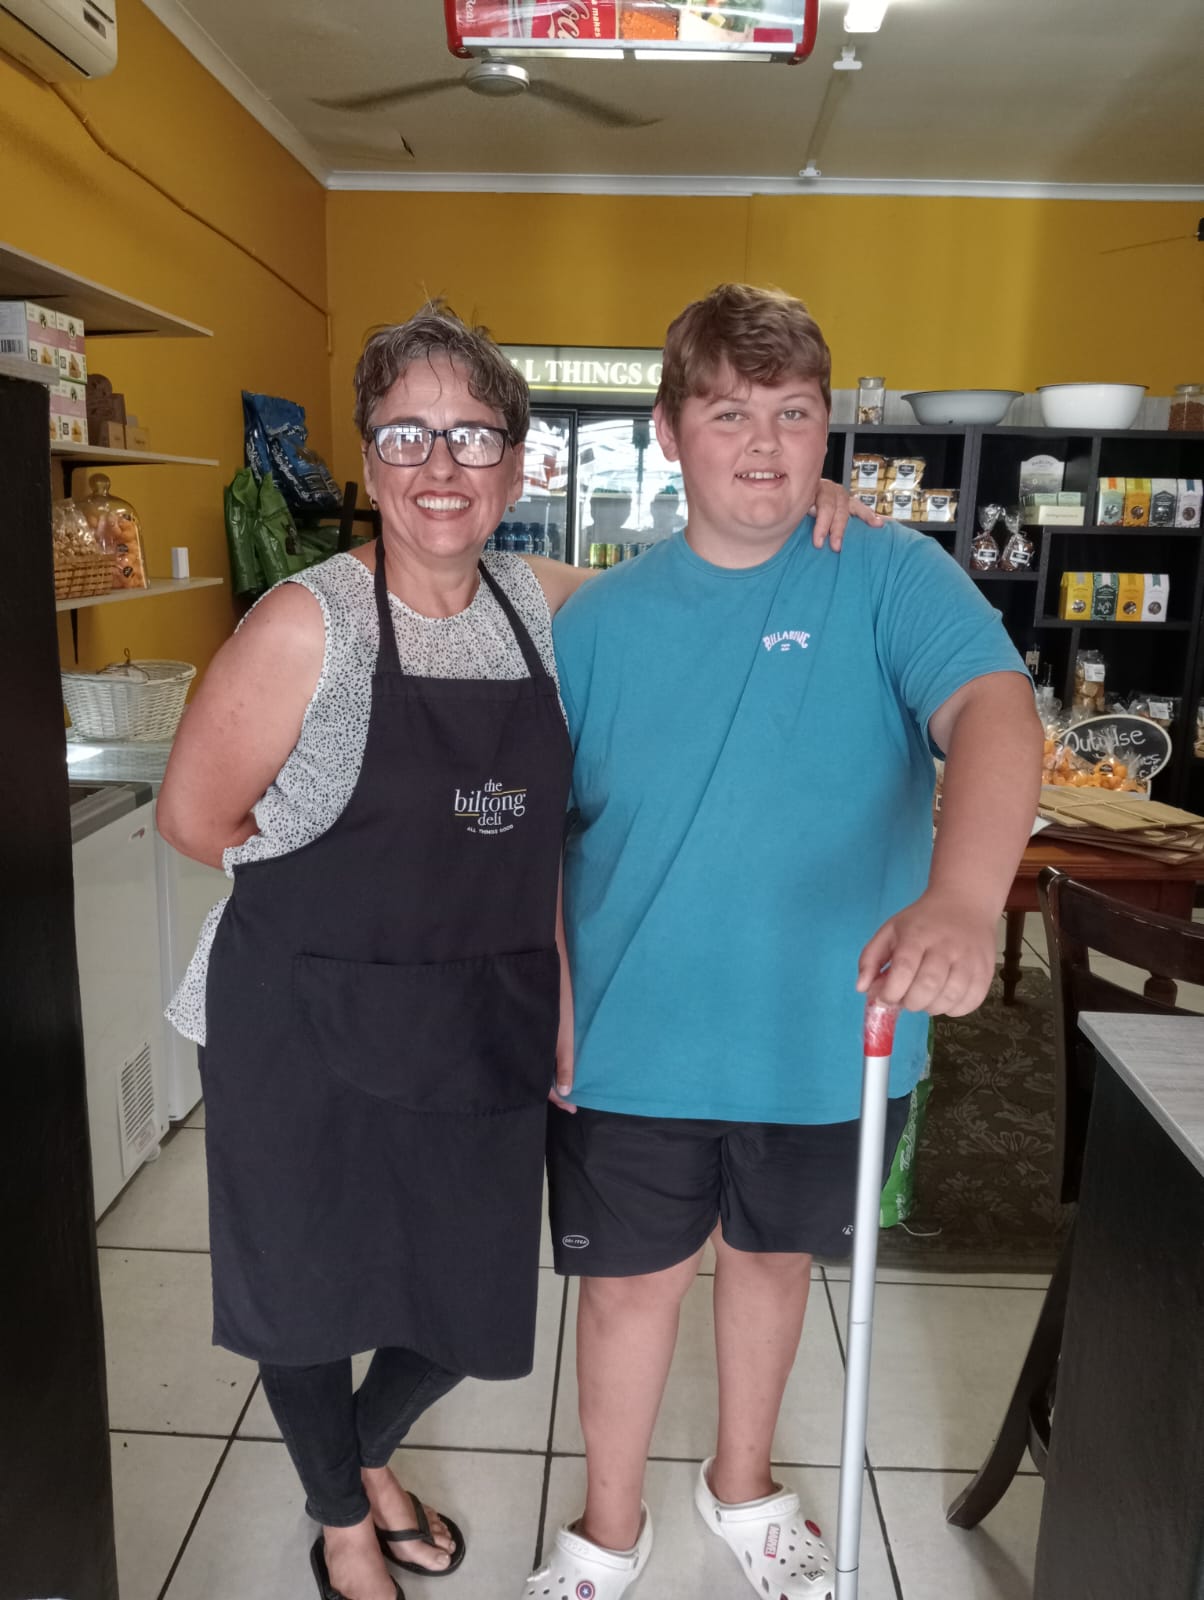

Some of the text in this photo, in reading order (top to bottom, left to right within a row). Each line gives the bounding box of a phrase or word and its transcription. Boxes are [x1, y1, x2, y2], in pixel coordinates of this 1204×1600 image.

[545, 360, 642, 385] THINGS
[484, 779, 503, 792] the
[454, 789, 525, 817] biltong
[477, 812, 502, 826] deli
